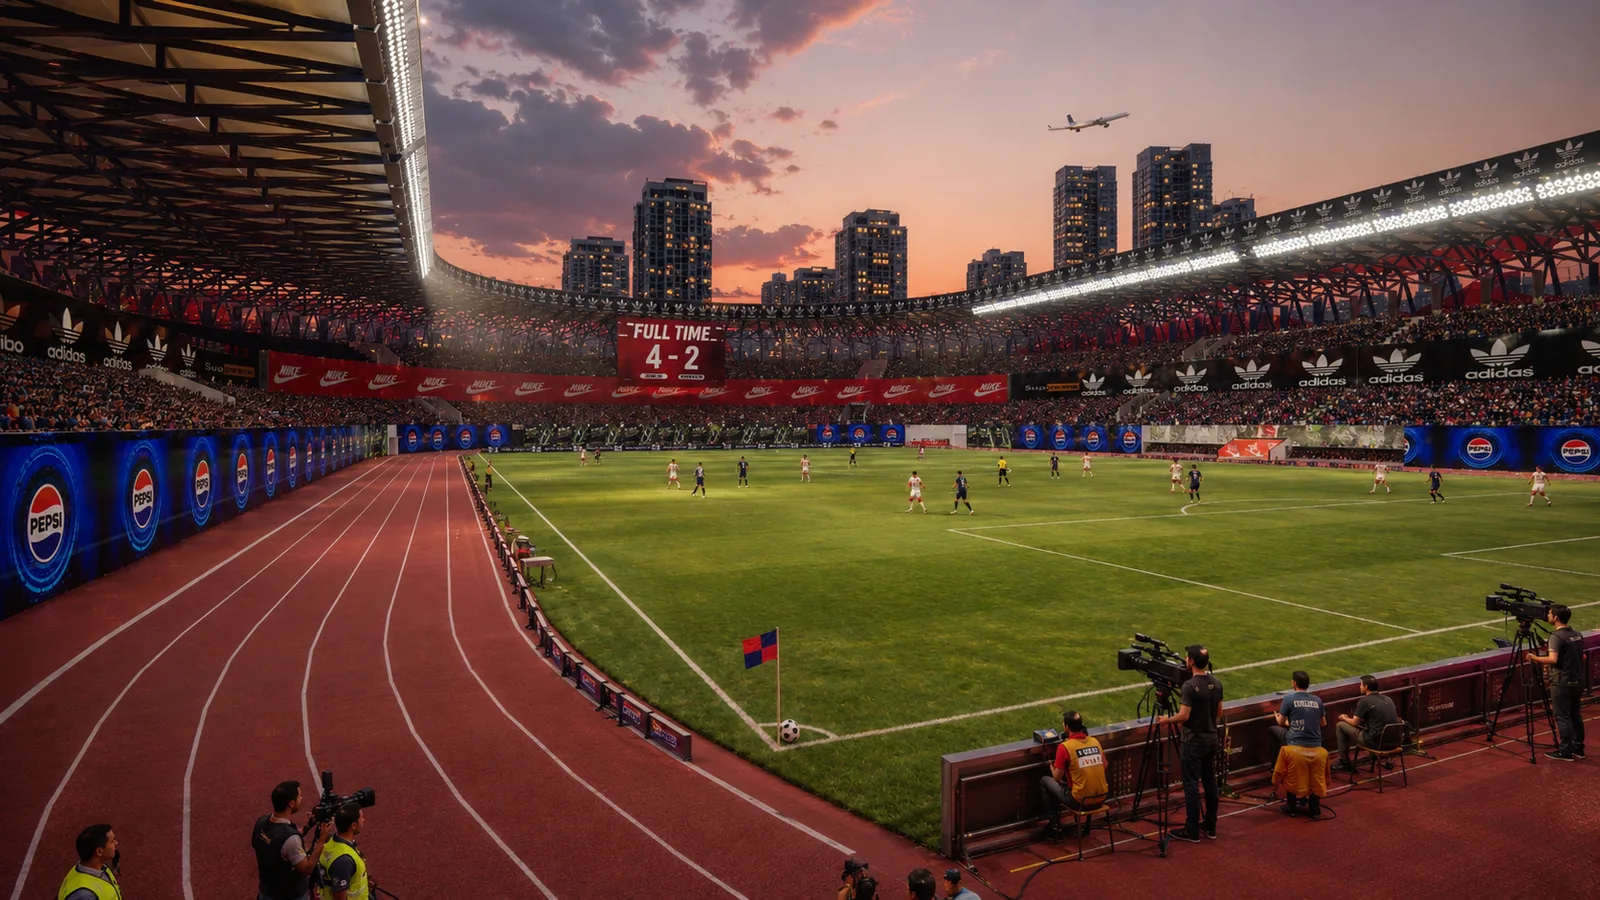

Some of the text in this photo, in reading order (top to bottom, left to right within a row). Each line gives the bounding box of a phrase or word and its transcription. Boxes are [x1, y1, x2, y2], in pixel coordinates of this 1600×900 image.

[633, 323, 711, 341] FULL TIME
[47, 345, 86, 363] adidas
[645, 344, 662, 369] 4
[684, 345, 700, 370] 2
[1368, 372, 1424, 384] adidas
[1464, 367, 1534, 380] adidas
[980, 382, 1002, 391] NIKE
[1231, 379, 1272, 390] adidas
[1298, 376, 1347, 387] adidas
[134, 490, 152, 507] PEPSI
[30, 512, 62, 535] PEPSI
